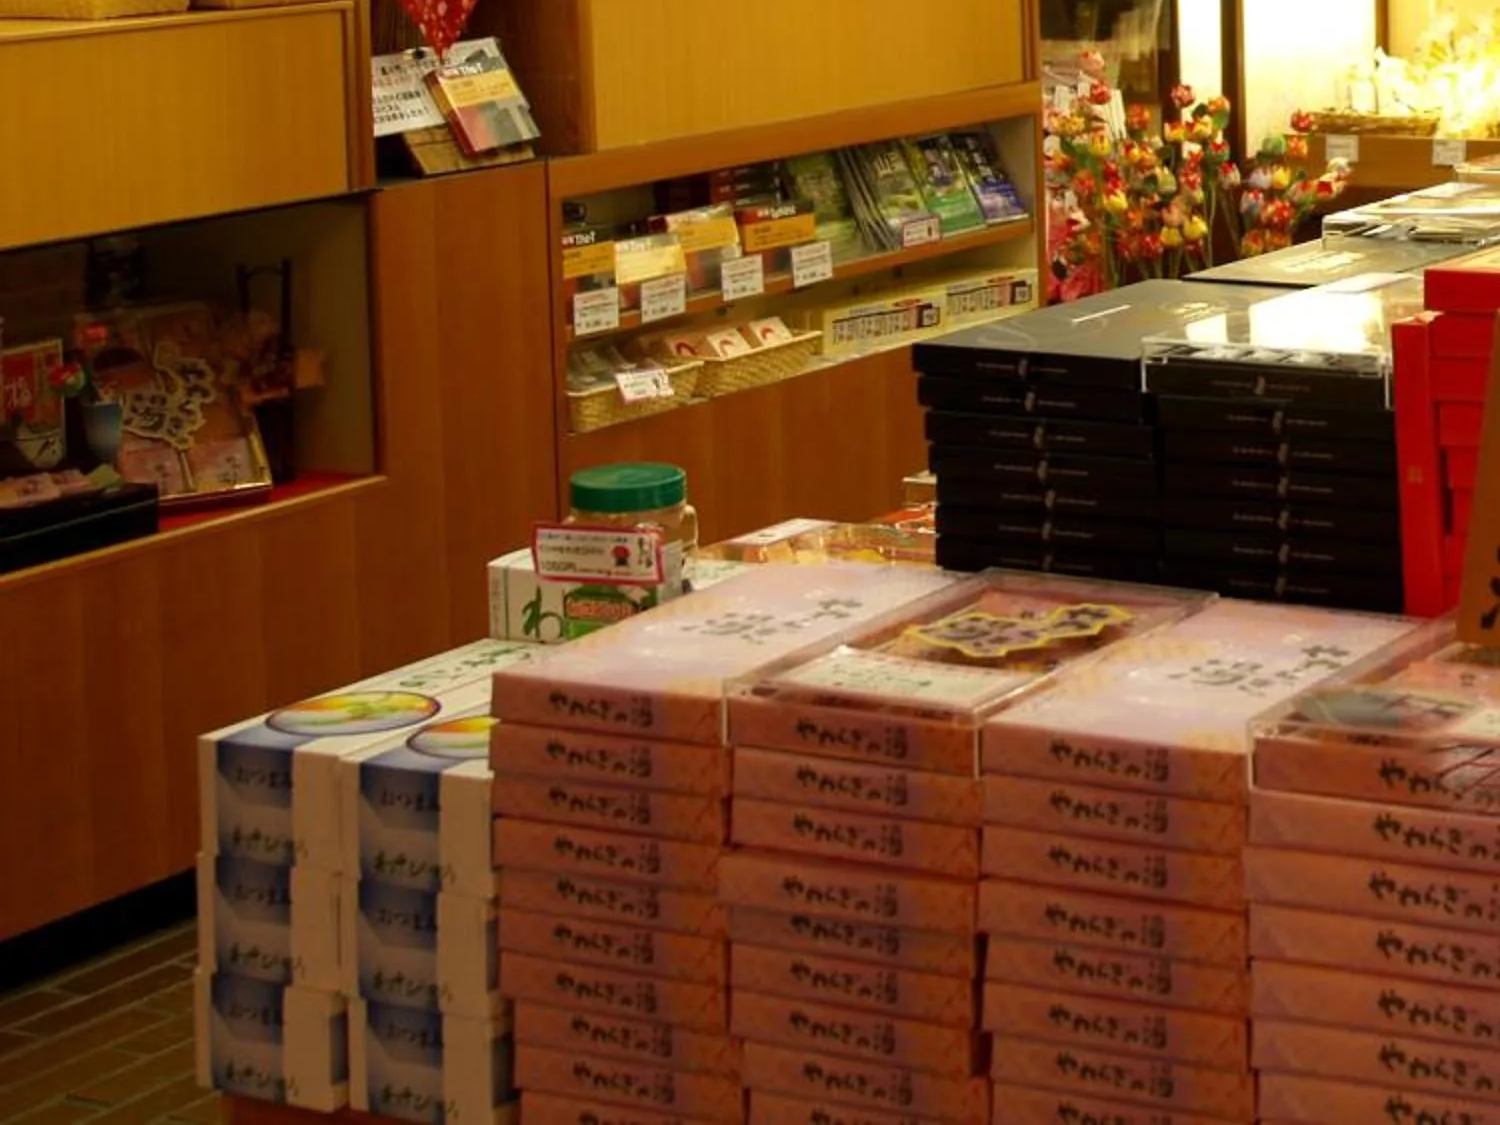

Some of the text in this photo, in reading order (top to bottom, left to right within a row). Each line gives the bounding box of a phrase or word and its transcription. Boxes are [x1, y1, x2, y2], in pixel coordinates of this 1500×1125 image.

[1049, 739, 1170, 783] やわらぎの湯
[1049, 789, 1169, 834] やわらぎの湯
[1048, 844, 1169, 889] やわらぎの湯
[1045, 903, 1165, 949] やわらぎの湯
[1053, 950, 1172, 995] やわらぎの湯
[1049, 1002, 1168, 1050] やわらぎの湯
[1057, 1051, 1174, 1099] やわらぎの湯
